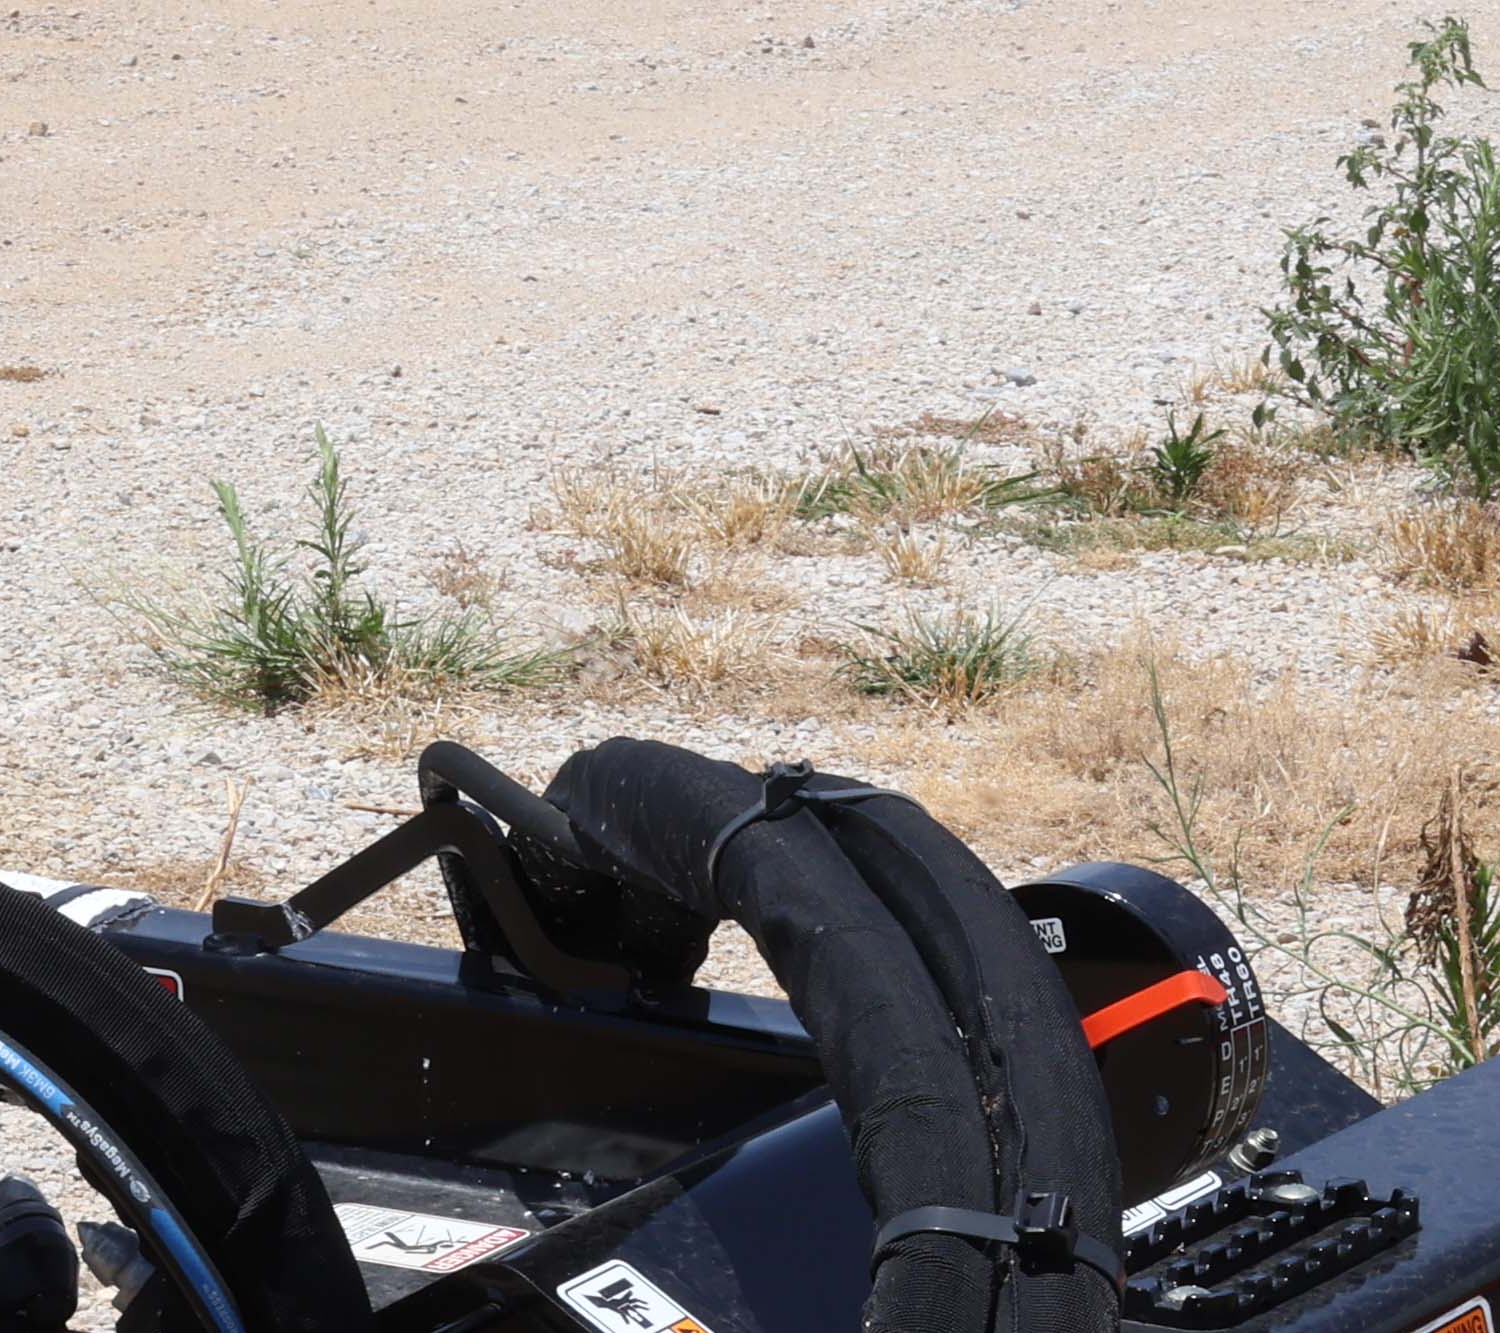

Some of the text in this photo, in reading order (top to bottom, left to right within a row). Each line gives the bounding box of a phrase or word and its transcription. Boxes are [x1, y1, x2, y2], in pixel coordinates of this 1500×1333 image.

[1209, 953, 1244, 1026] TR48
[1227, 946, 1261, 1019] TR60
[20, 1063, 57, 1099] 6M3K
[424, 1235, 510, 1270] DANGER
